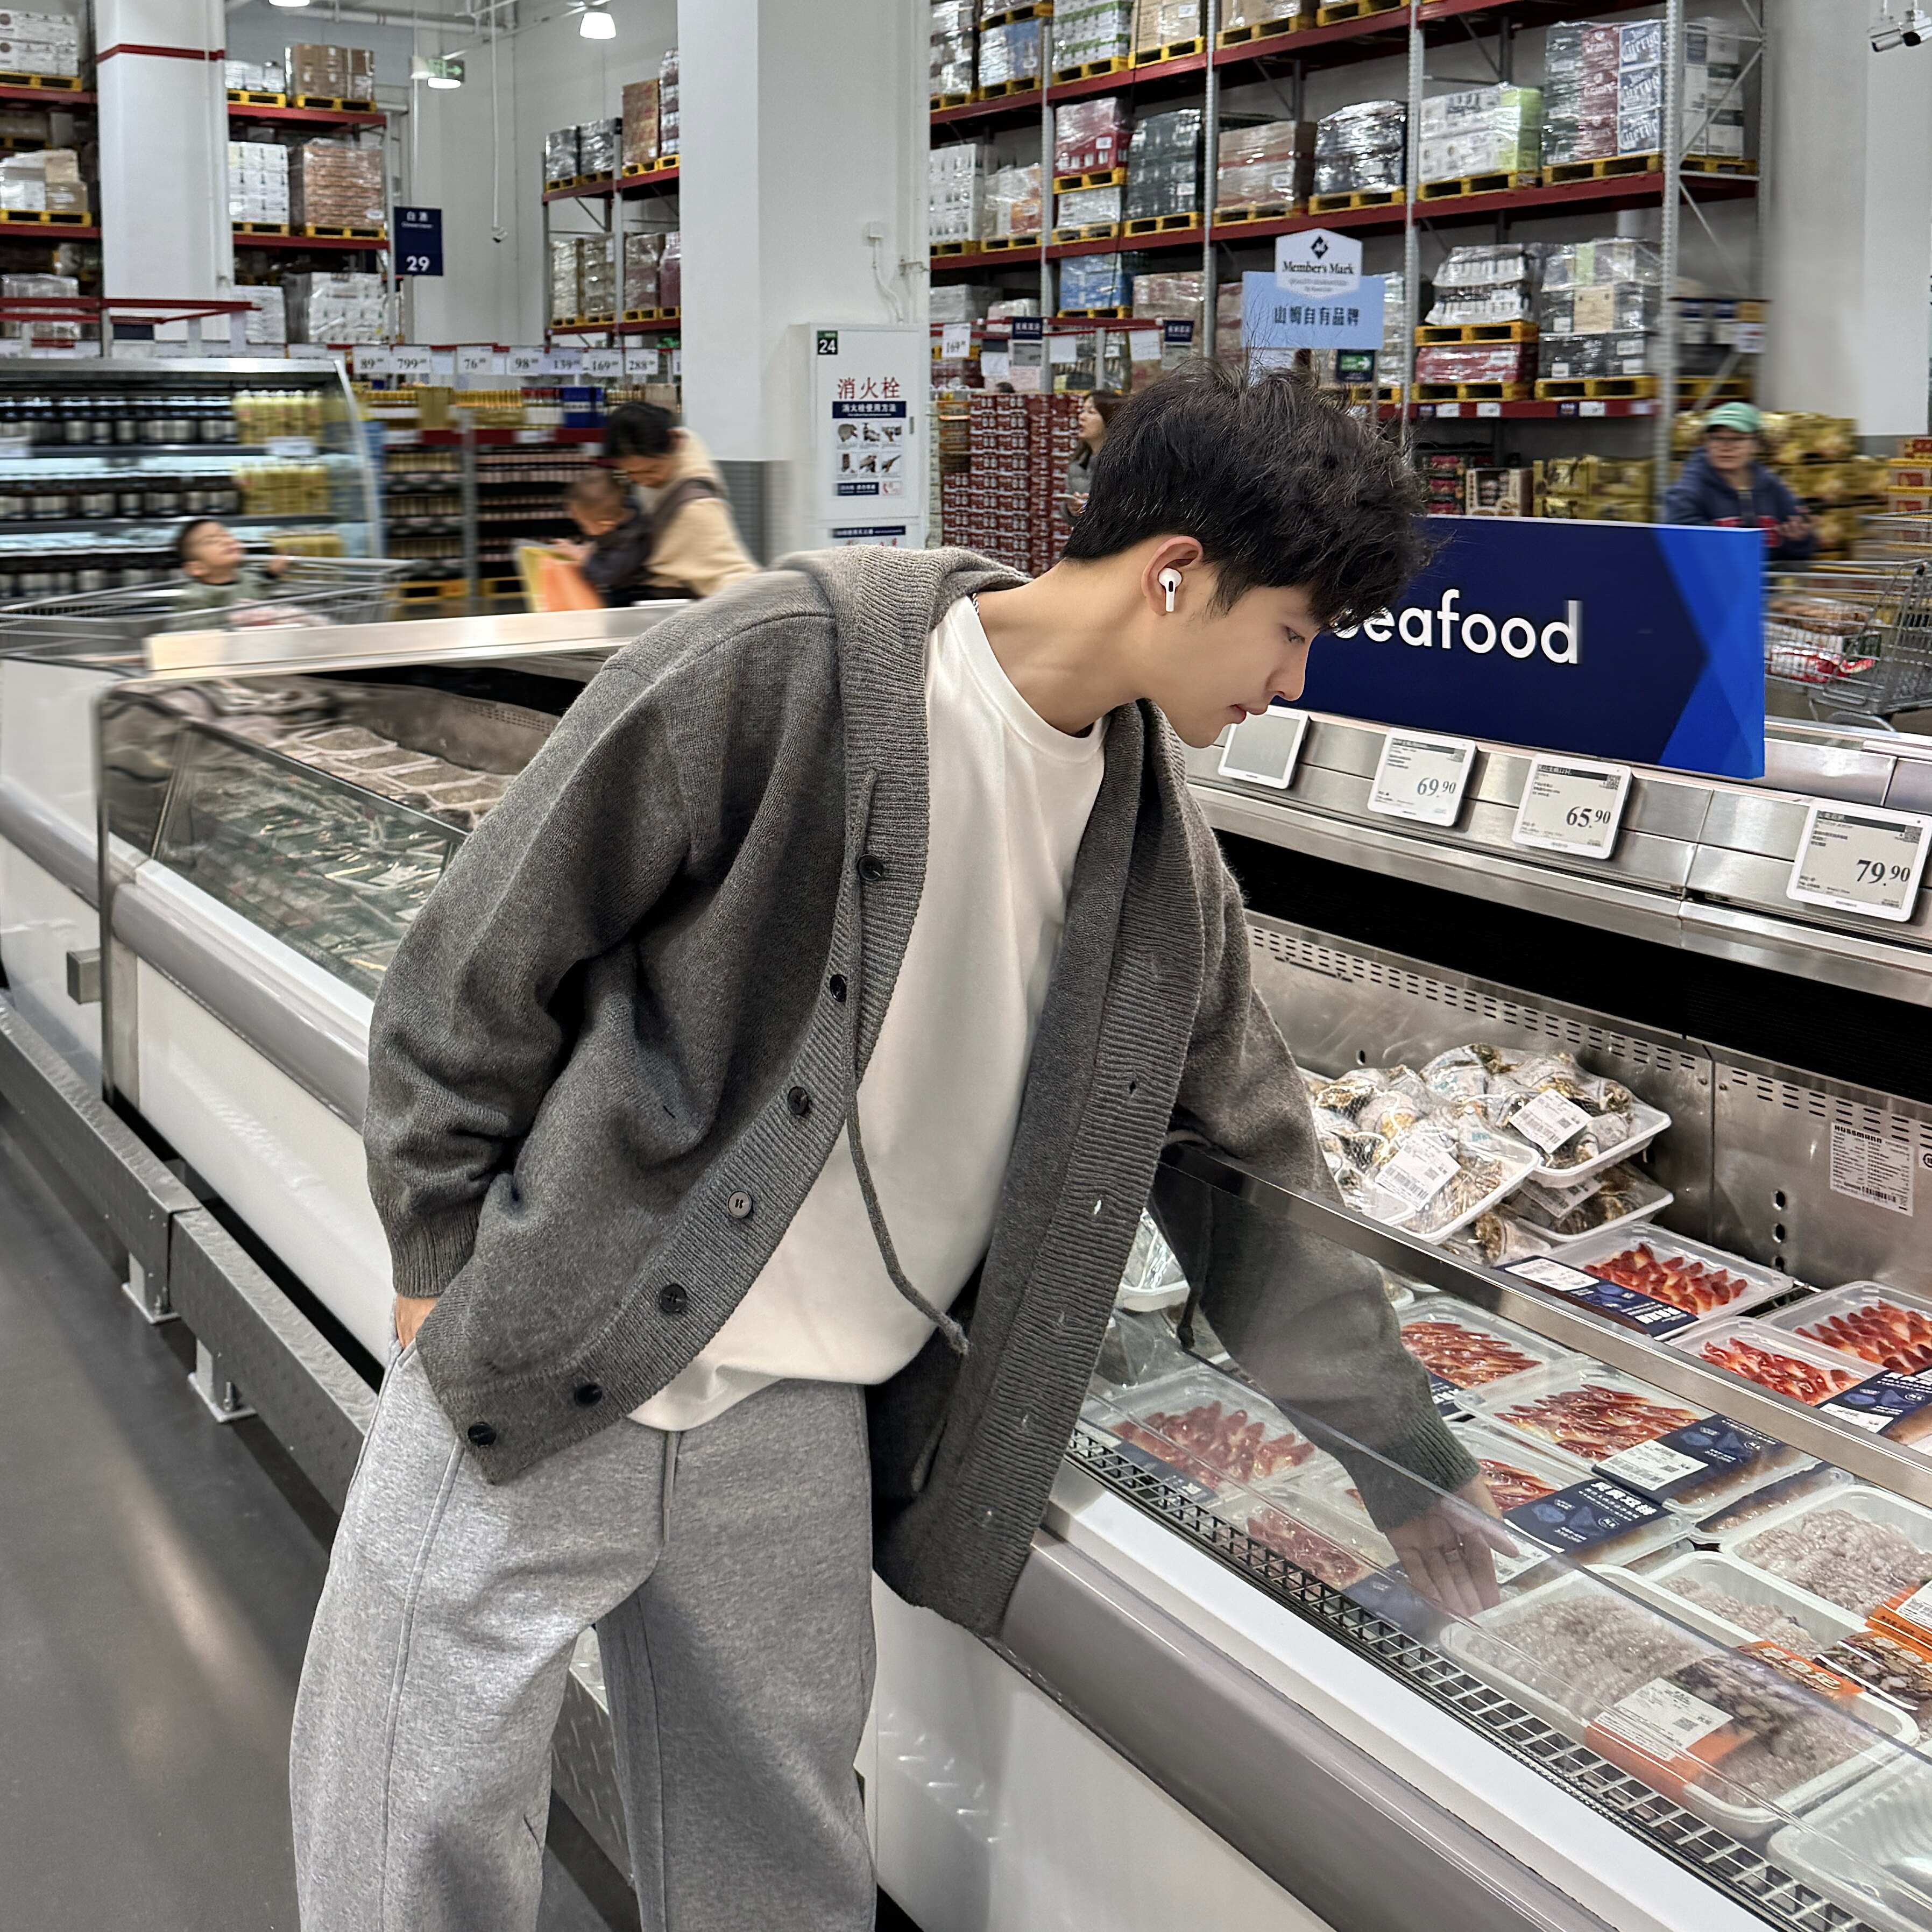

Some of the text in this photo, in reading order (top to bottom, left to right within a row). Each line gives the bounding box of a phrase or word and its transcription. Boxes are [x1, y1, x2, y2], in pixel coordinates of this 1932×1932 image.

[406, 256, 430, 271] 29
[1282, 261, 1354, 275] Member's Mark
[1274, 305, 1360, 327] 山姆自有品牌
[819, 339, 836, 353] 24
[837, 377, 901, 399] 消火栓
[1417, 777, 1456, 798] 69.90
[1566, 806, 1611, 829] 65.90
[1856, 859, 1910, 886] 79.90
